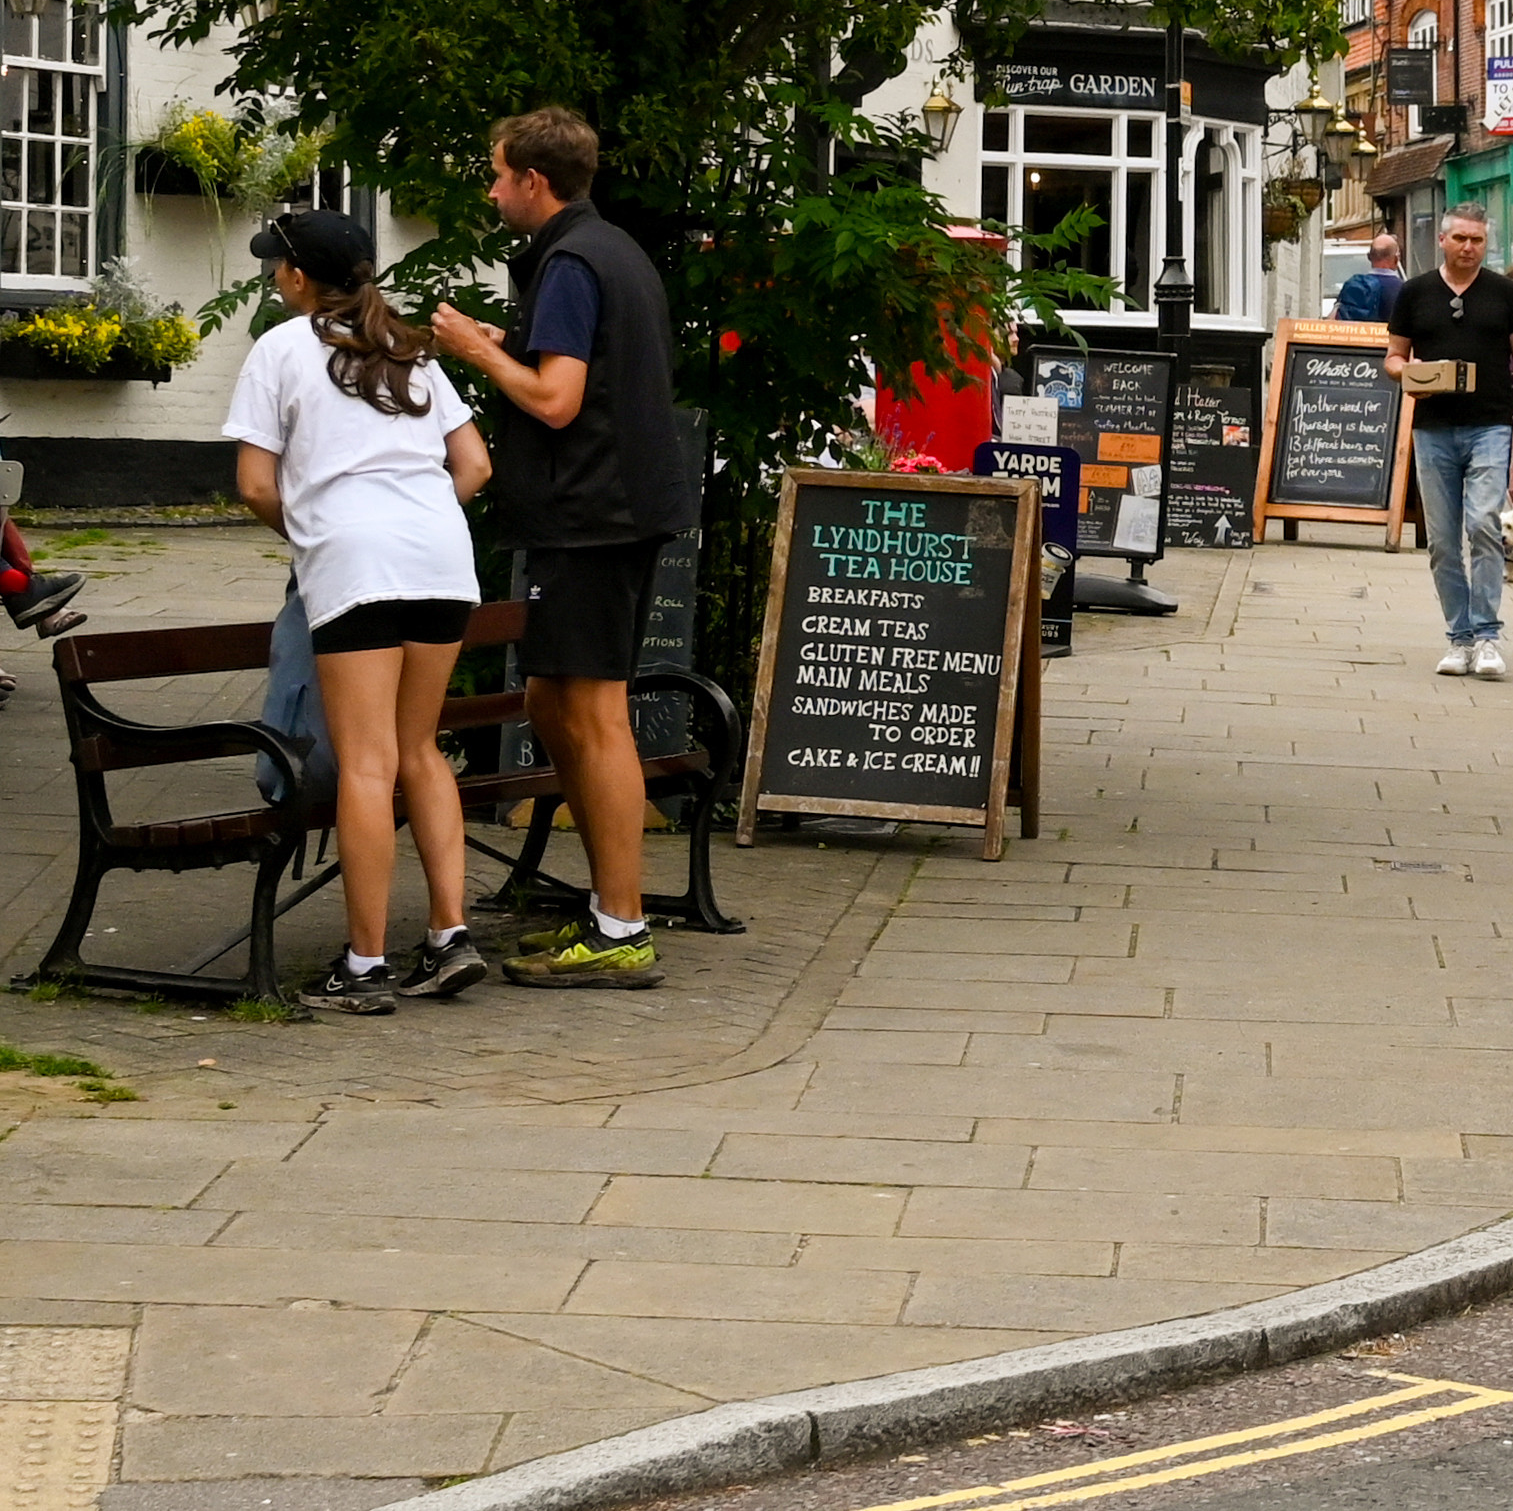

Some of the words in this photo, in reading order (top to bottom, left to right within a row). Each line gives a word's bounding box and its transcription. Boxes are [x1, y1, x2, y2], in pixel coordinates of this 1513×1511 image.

[996, 64, 1038, 75] DISCOVER
[1040, 66, 1058, 76] OUR
[1069, 73, 1157, 97] GARDEN
[1493, 84, 1508, 94] TO
[1294, 322, 1326, 332] FULLER
[1328, 324, 1358, 334] SMITH
[1103, 362, 1154, 375] WELCOME
[1306, 358, 1352, 378] What's
[1354, 362, 1378, 379] On
[1112, 378, 1142, 391] BACK
[1296, 389, 1338, 414] Another
[1364, 400, 1382, 417] for
[1292, 414, 1342, 438] Thursday
[1346, 422, 1356, 431] is
[1289, 435, 1302, 452] 13
[1302, 437, 1339, 452] different
[1340, 438, 1363, 451] beers
[993, 450, 1062, 474] YARDE
[1308, 452, 1333, 464] there
[1286, 465, 1300, 481] for
[1300, 468, 1344, 484] everyone
[861, 499, 928, 528] THE
[812, 525, 977, 560] LYNDHURST
[661, 557, 692, 568] CHES
[819, 553, 881, 579] TEA
[888, 558, 973, 585] HOUSE
[654, 595, 684, 608] ROLL
[806, 586, 925, 609] BREAKFASTS
[649, 611, 664, 621] ES
[801, 615, 871, 638] CREAM
[877, 619, 930, 641] TEAS
[642, 637, 684, 648] PTIONS
[800, 642, 886, 666] GLUTEN
[890, 648, 940, 671] FREE
[942, 651, 1002, 676] MENU
[796, 665, 853, 689] MAIN
[857, 669, 931, 694] MEALS
[791, 696, 914, 722] SANDWICHES
[919, 703, 977, 725] MADE
[868, 723, 901, 743] TO
[910, 726, 977, 748] ORDER
[787, 747, 843, 768] CAKE
[846, 752, 859, 768] &
[863, 750, 897, 771] ICE
[901, 753, 982, 778] CREAM!!
